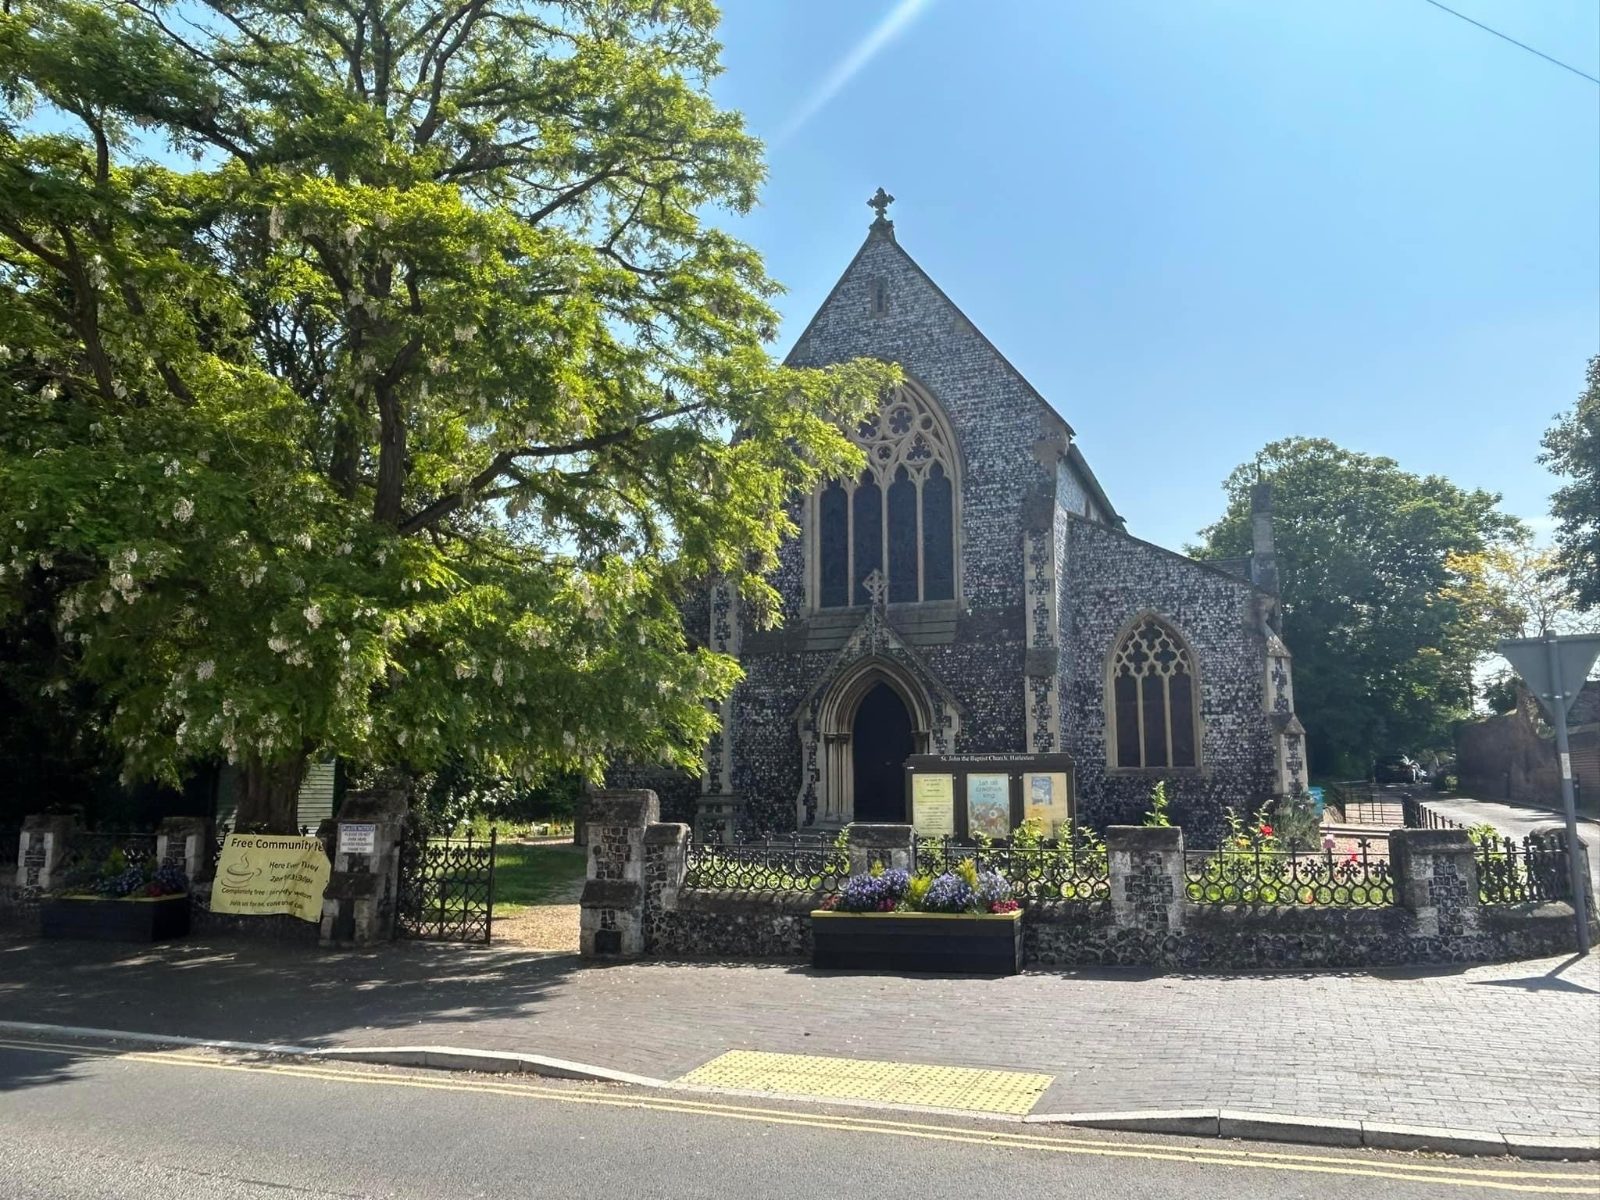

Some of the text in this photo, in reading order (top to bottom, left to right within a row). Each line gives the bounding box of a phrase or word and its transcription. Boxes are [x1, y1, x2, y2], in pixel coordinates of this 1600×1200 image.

[231, 838, 253, 848] Free
[256, 839, 314, 852] Community
[269, 861, 285, 869] Here
